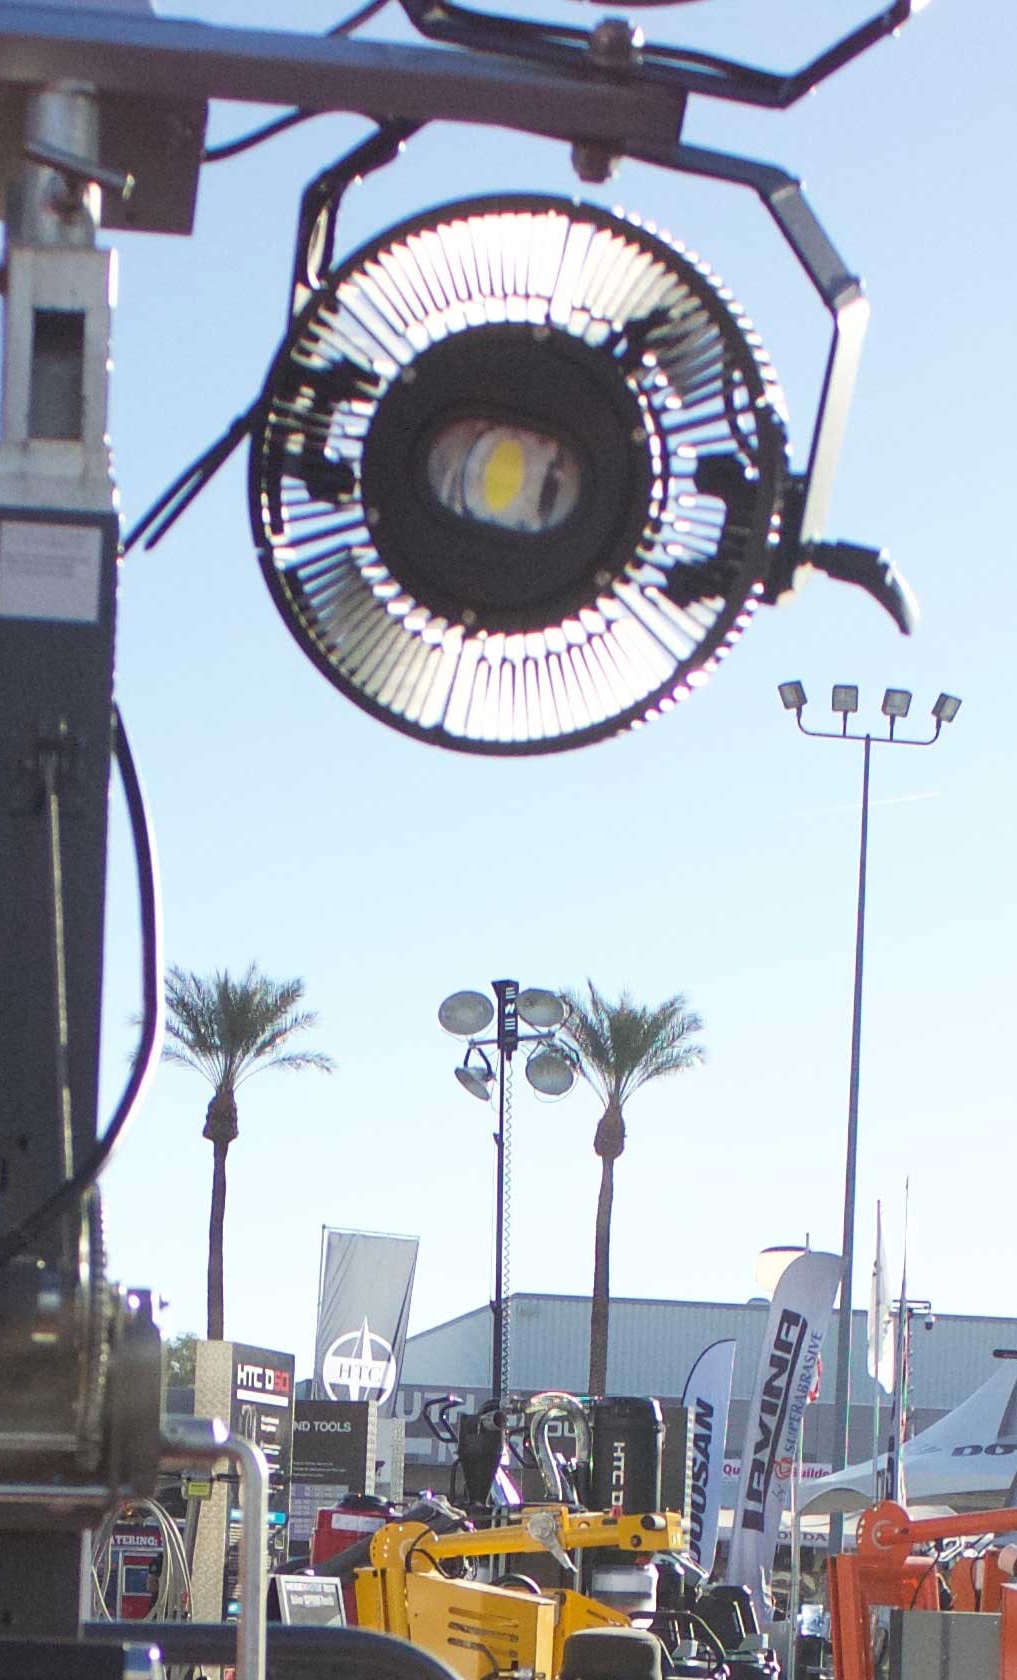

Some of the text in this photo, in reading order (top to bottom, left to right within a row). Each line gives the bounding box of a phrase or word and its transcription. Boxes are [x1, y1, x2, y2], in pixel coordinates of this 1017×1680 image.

[237, 1363, 263, 1389] HTC
[339, 1363, 381, 1383] HTC
[785, 1330, 823, 1452] SUPERABRASIVE
[313, 1421, 352, 1433] TOOLS
[612, 1441, 626, 1486] HTC
